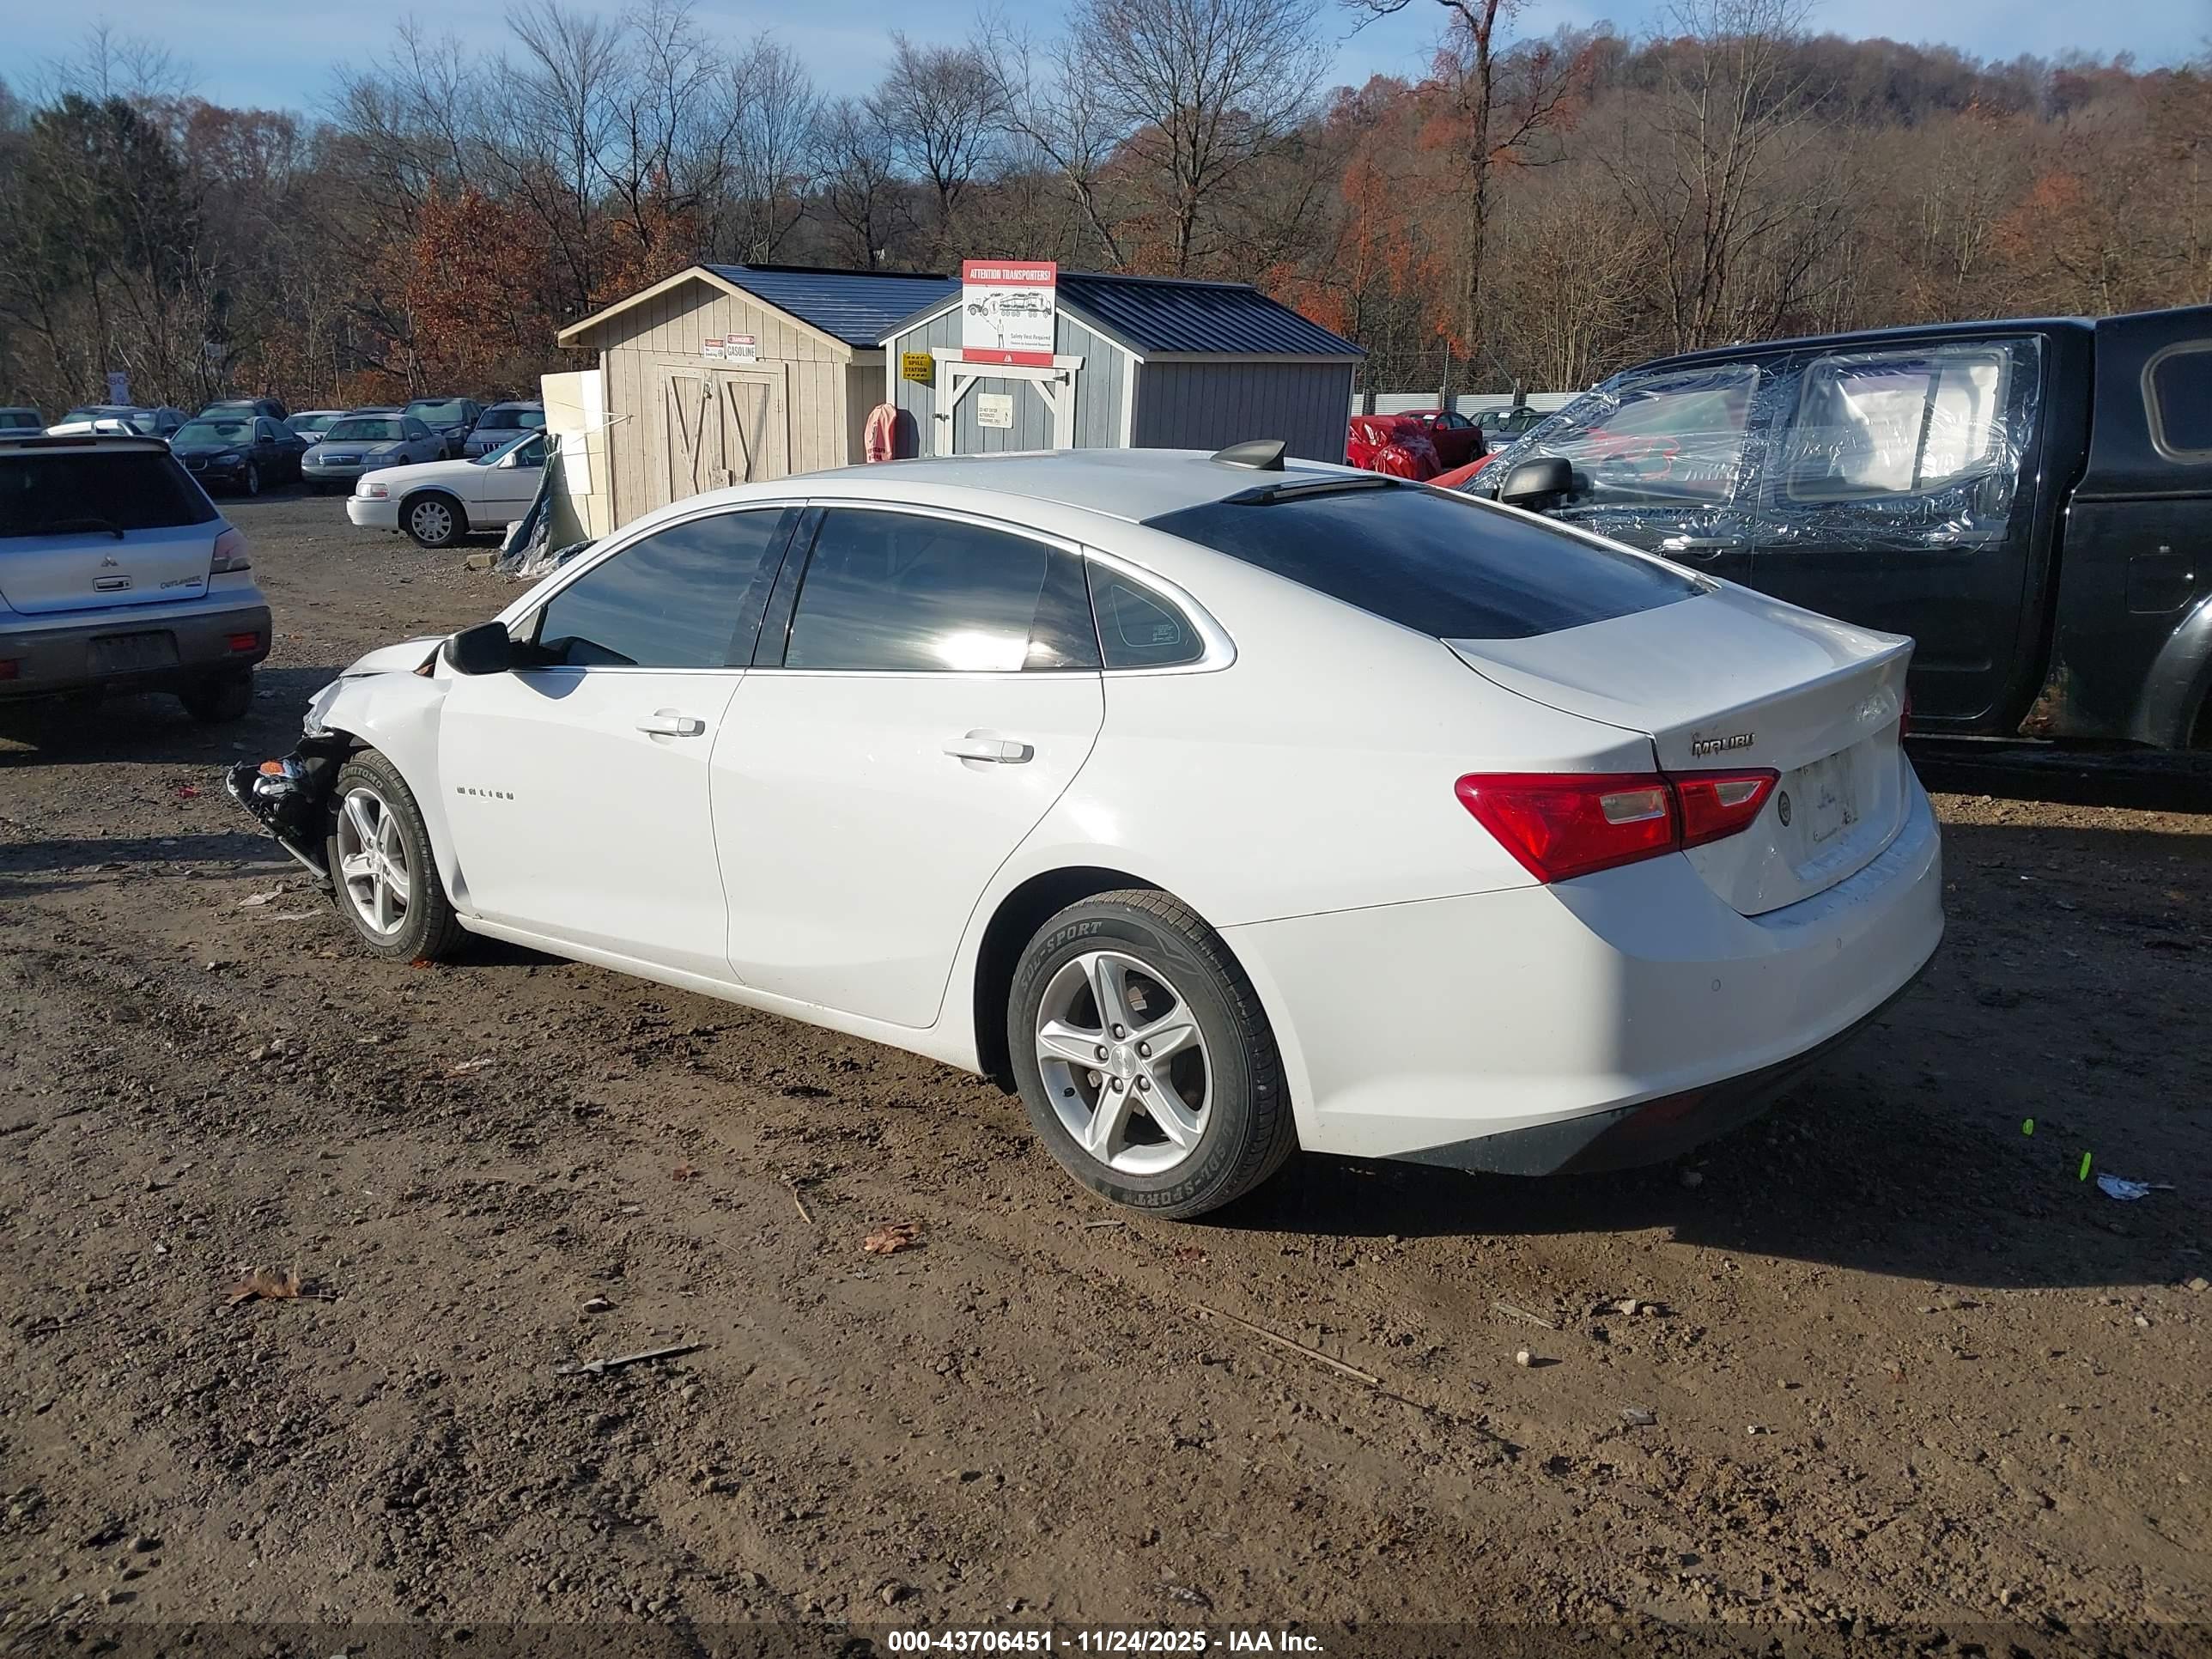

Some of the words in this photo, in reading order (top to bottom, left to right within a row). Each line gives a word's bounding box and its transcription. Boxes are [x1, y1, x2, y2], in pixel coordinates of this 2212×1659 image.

[969, 268, 1001, 279] ATTENTION
[1002, 269, 1051, 281] TRANSPORTERS!
[727, 345, 755, 358] GASOLINE
[1692, 732, 1755, 756] MALIBU
